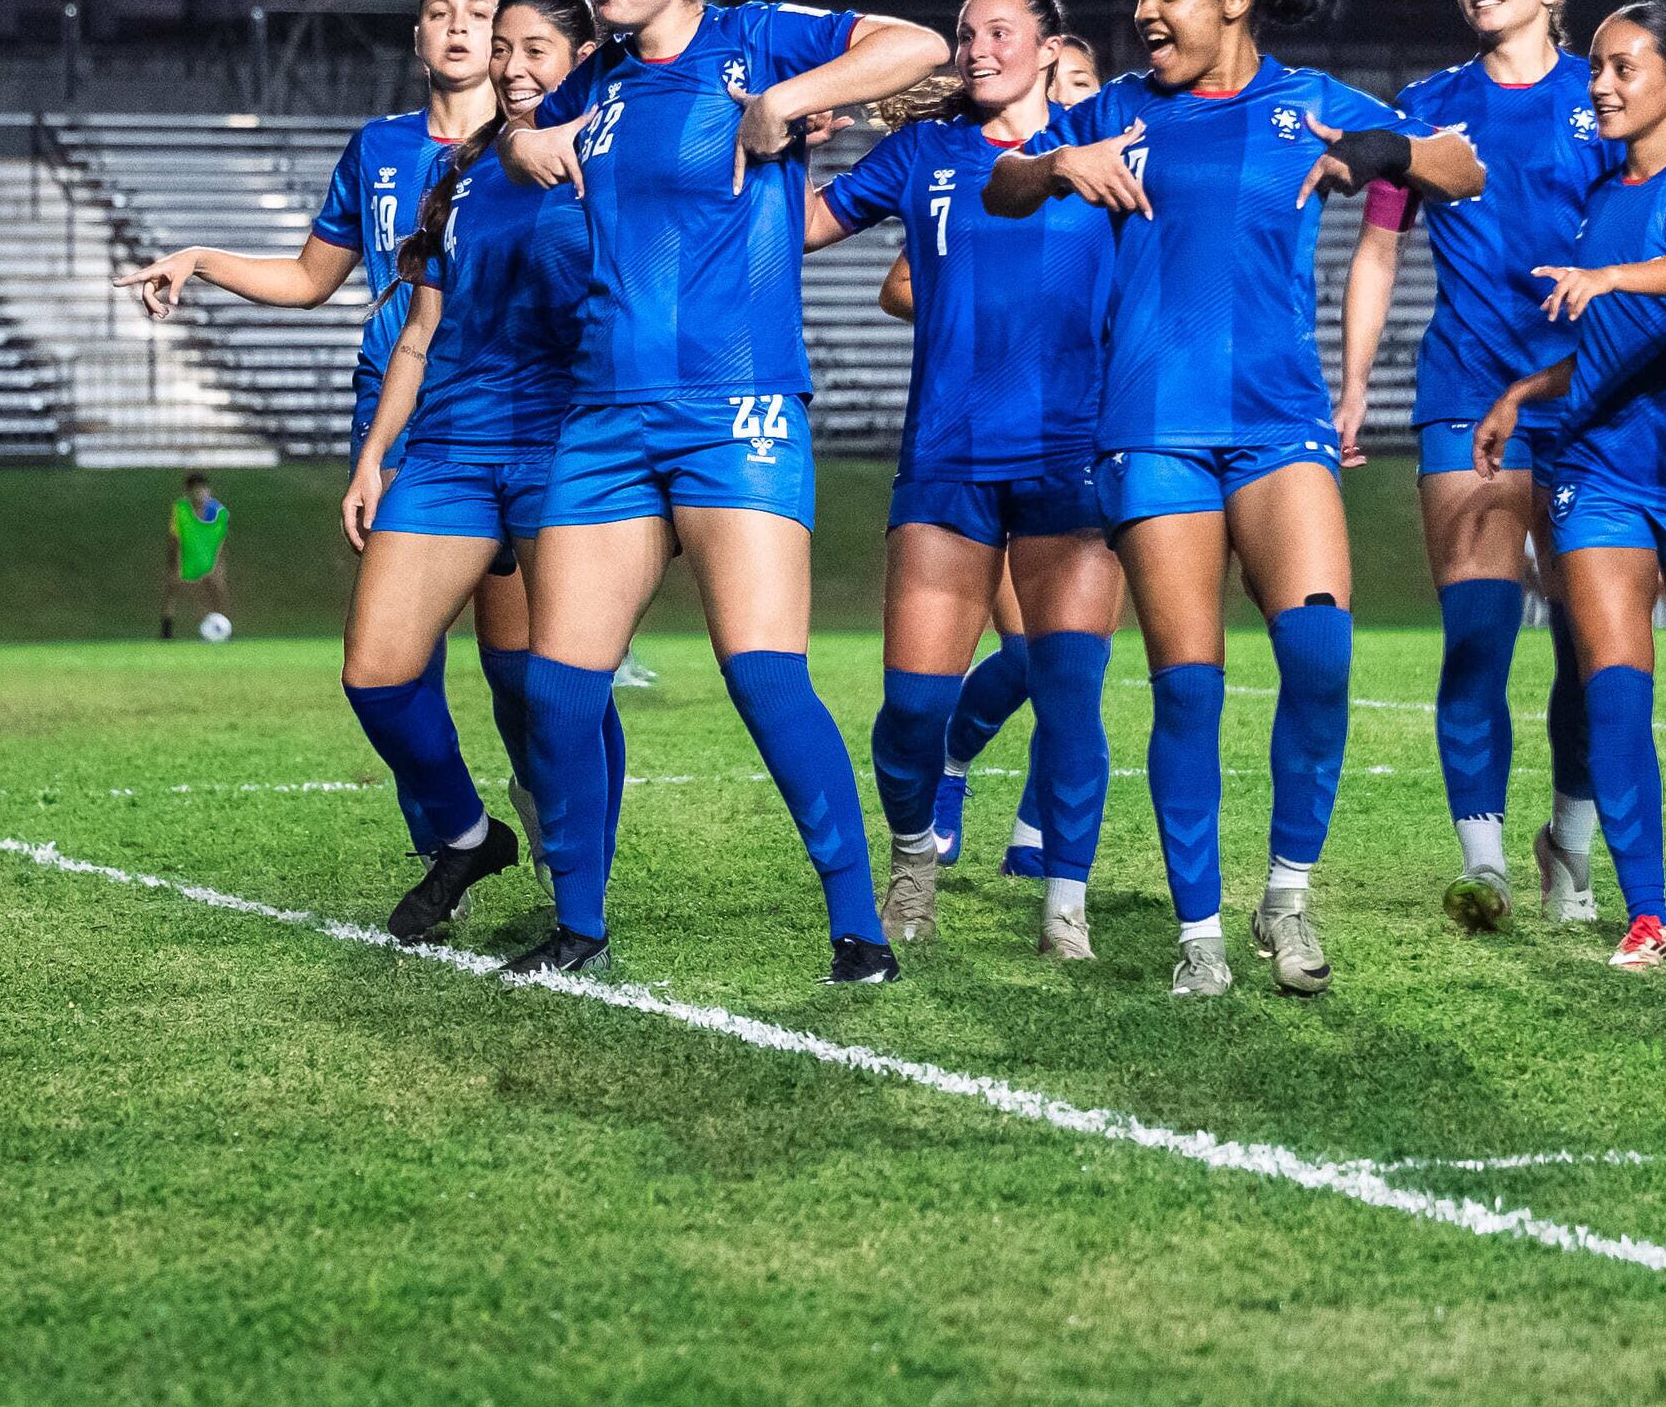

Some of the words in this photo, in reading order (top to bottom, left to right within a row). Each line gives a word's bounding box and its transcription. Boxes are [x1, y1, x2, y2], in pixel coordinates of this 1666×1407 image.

[371, 195, 398, 252] 19
[930, 197, 951, 256] 7
[729, 394, 788, 439] 22
